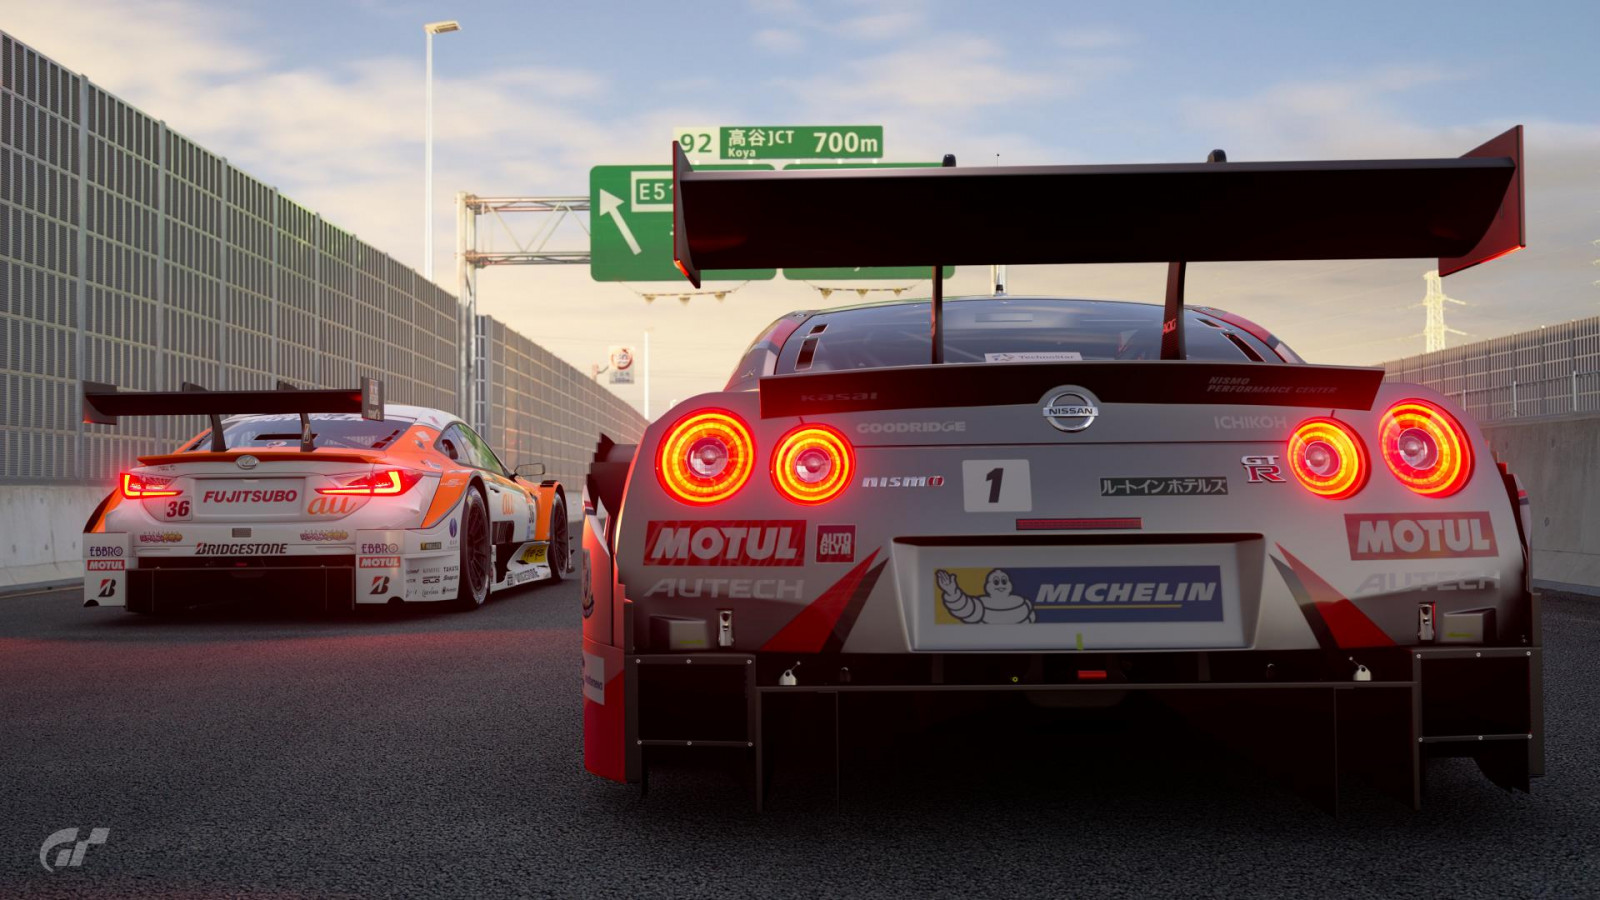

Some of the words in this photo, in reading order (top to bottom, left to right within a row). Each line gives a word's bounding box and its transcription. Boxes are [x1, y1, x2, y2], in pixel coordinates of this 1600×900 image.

[679, 133, 713, 153] 92
[813, 131, 878, 153] 700m
[727, 148, 757, 160] Koya
[639, 182, 673, 201] E5
[1208, 376, 1251, 385] NISMO
[1206, 384, 1294, 394] PERFORMANCE
[1295, 386, 1338, 394] CENTER
[1048, 407, 1093, 416] NISSAN
[856, 420, 967, 434] GOODRIDGE
[1213, 415, 1288, 430] ICHIKOH
[985, 466, 1004, 504] 1
[203, 489, 297, 504] FUJITSUBO
[166, 500, 191, 518] 36
[306, 495, 357, 516] au
[650, 526, 798, 561] MOTUL
[821, 532, 852, 544] AUTO
[1356, 518, 1492, 554] MOTUL
[89, 546, 123, 557] EBBRO
[194, 542, 288, 556] BRIDGESTONE
[361, 543, 399, 555] EBBRO
[819, 543, 851, 556] GLYM
[89, 560, 124, 570] MOTUL
[360, 557, 400, 567] MOTUL
[643, 577, 805, 600] AUTECH
[1354, 569, 1501, 594] AUTECH
[1036, 581, 1217, 604] MICHELIN
